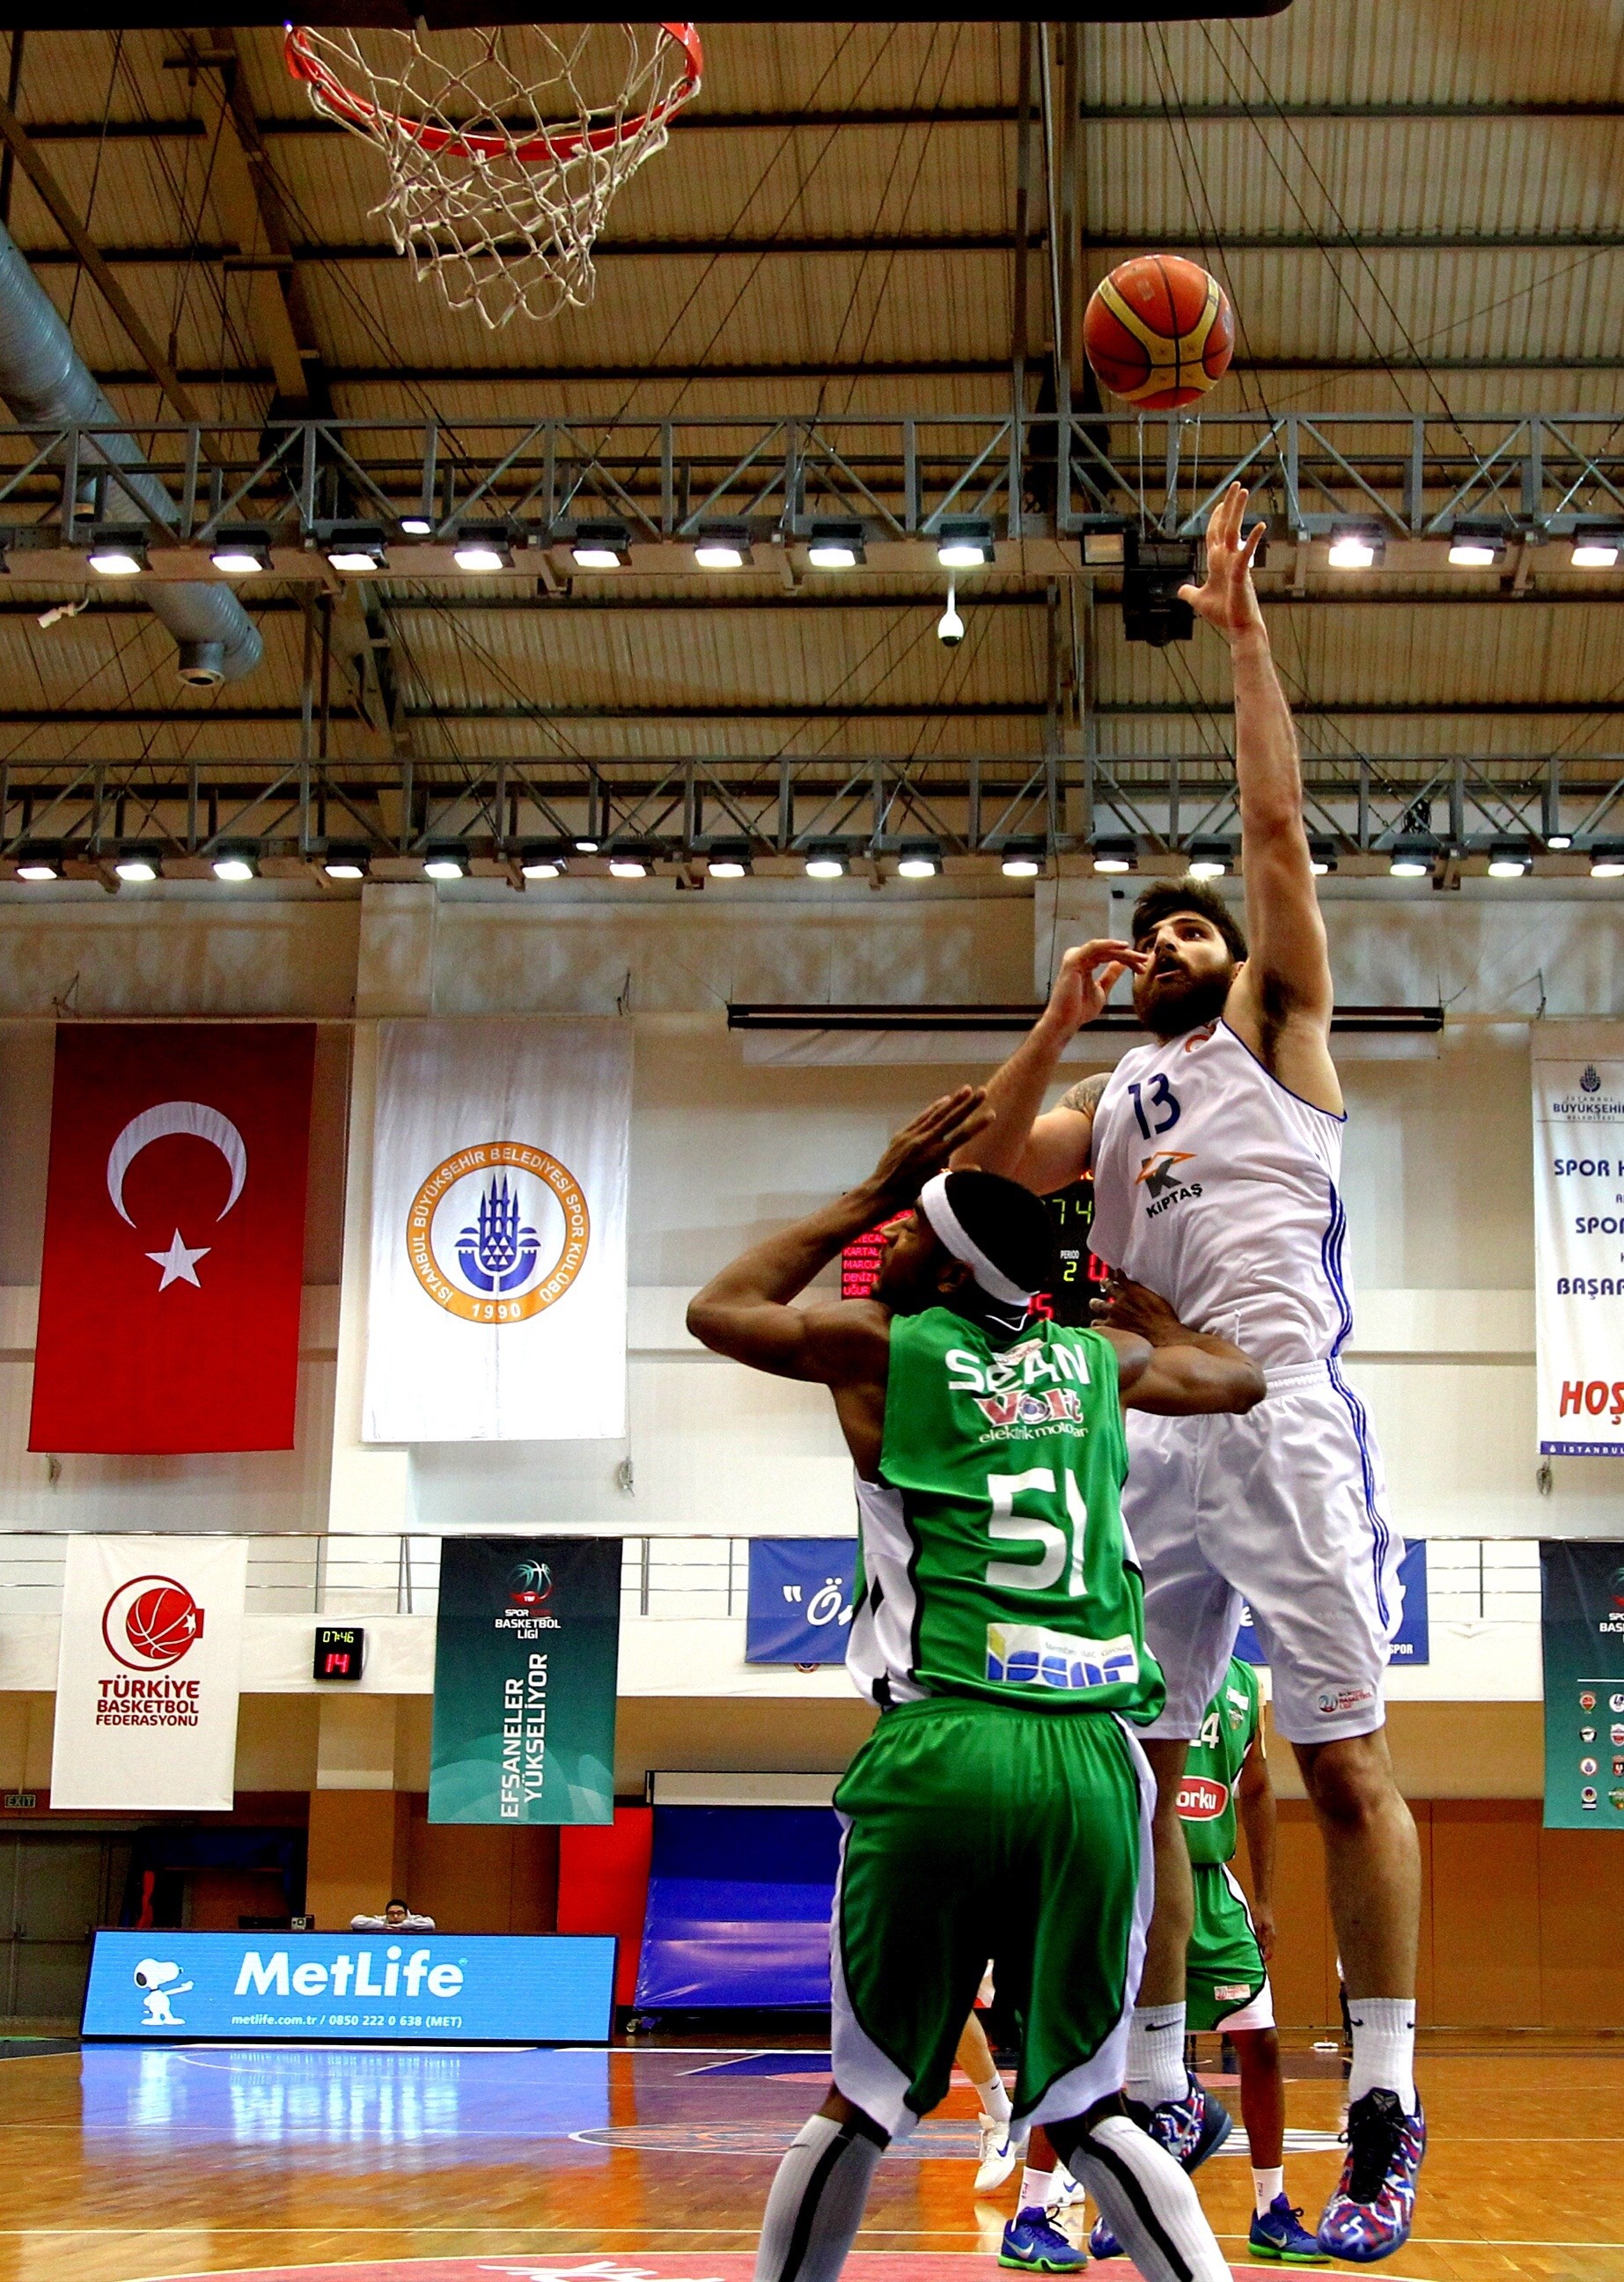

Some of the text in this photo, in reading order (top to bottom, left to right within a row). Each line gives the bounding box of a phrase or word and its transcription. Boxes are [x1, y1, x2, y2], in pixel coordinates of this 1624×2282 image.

[1128, 1073, 1181, 1140] 13
[1554, 1159, 1610, 1176] SPOR
[413, 1147, 584, 1304] İSTANBUL BÜYÜKŞEHİR BELEDİYESİ SPOR KULÜBÜ
[1063, 1262, 1077, 1282] 2
[842, 1284, 870, 1295] UĞUR
[472, 1302, 521, 1318] 1990
[986, 1468, 1088, 1597] 51
[495, 1618, 562, 1629] BASKETBOL
[1599, 1623, 1624, 1632] BAS
[322, 1631, 354, 1643] 07:46
[517, 1628, 539, 1639] LİGİ
[326, 1653, 349, 1673] 14
[98, 1675, 201, 1699] TÜRKİYE
[97, 1699, 200, 1714] BASKETBOL
[96, 1714, 198, 1726] FEDERASYONU
[521, 1653, 548, 1804] YÜKSELİYOR
[501, 1678, 524, 1818] EFSANELER
[8, 1796, 33, 1806] EXIT
[1176, 1786, 1216, 1810] orku
[233, 1945, 464, 1998] MetLife
[231, 2014, 317, 2026] metlife.com.tr
[329, 2015, 358, 2026] 0850
[362, 2015, 385, 2026] 222
[388, 2016, 396, 2026] 0
[400, 2016, 422, 2027] 638
[426, 2016, 462, 2028] (MET)
